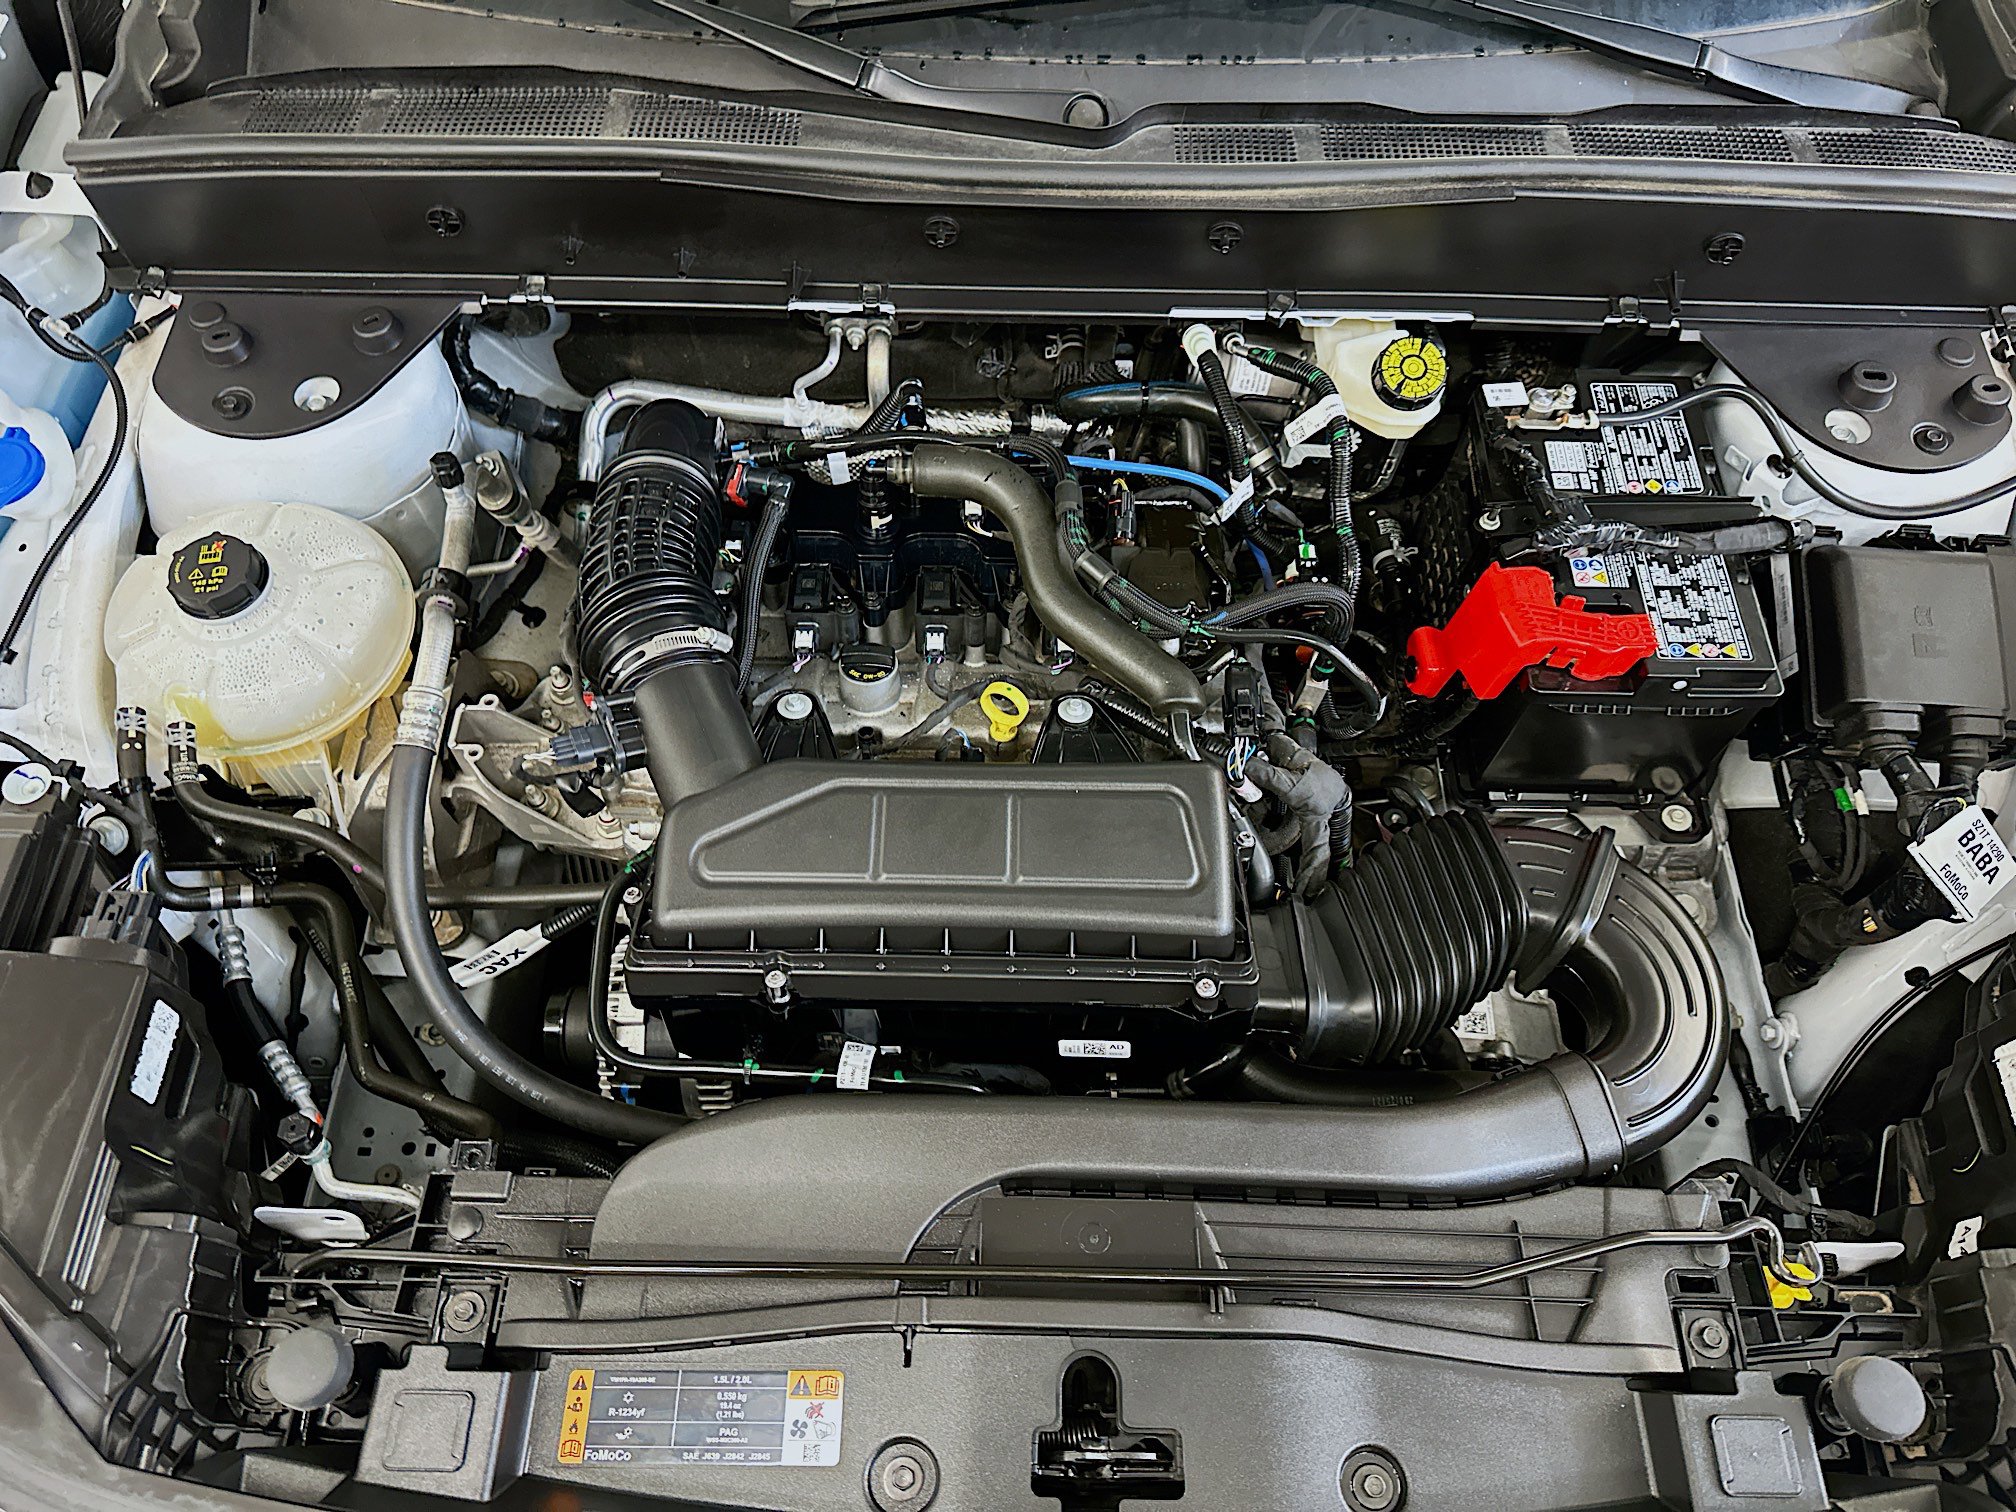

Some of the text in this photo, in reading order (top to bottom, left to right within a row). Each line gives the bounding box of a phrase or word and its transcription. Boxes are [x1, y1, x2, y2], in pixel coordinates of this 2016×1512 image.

[1972, 819, 2005, 862] SZ1T 14290
[1958, 829, 2000, 885] BABA
[1940, 863, 1969, 900] FoMoCo
[479, 948, 527, 975] XAC
[713, 1375, 730, 1384] 1.5L
[735, 1375, 752, 1384] 2.0L
[737, 1392, 748, 1403] kg
[608, 1407, 646, 1418] R-1234yf
[719, 1427, 739, 1437] PAG
[584, 1449, 632, 1461] FoMoCo
[682, 1452, 700, 1460] SAE
